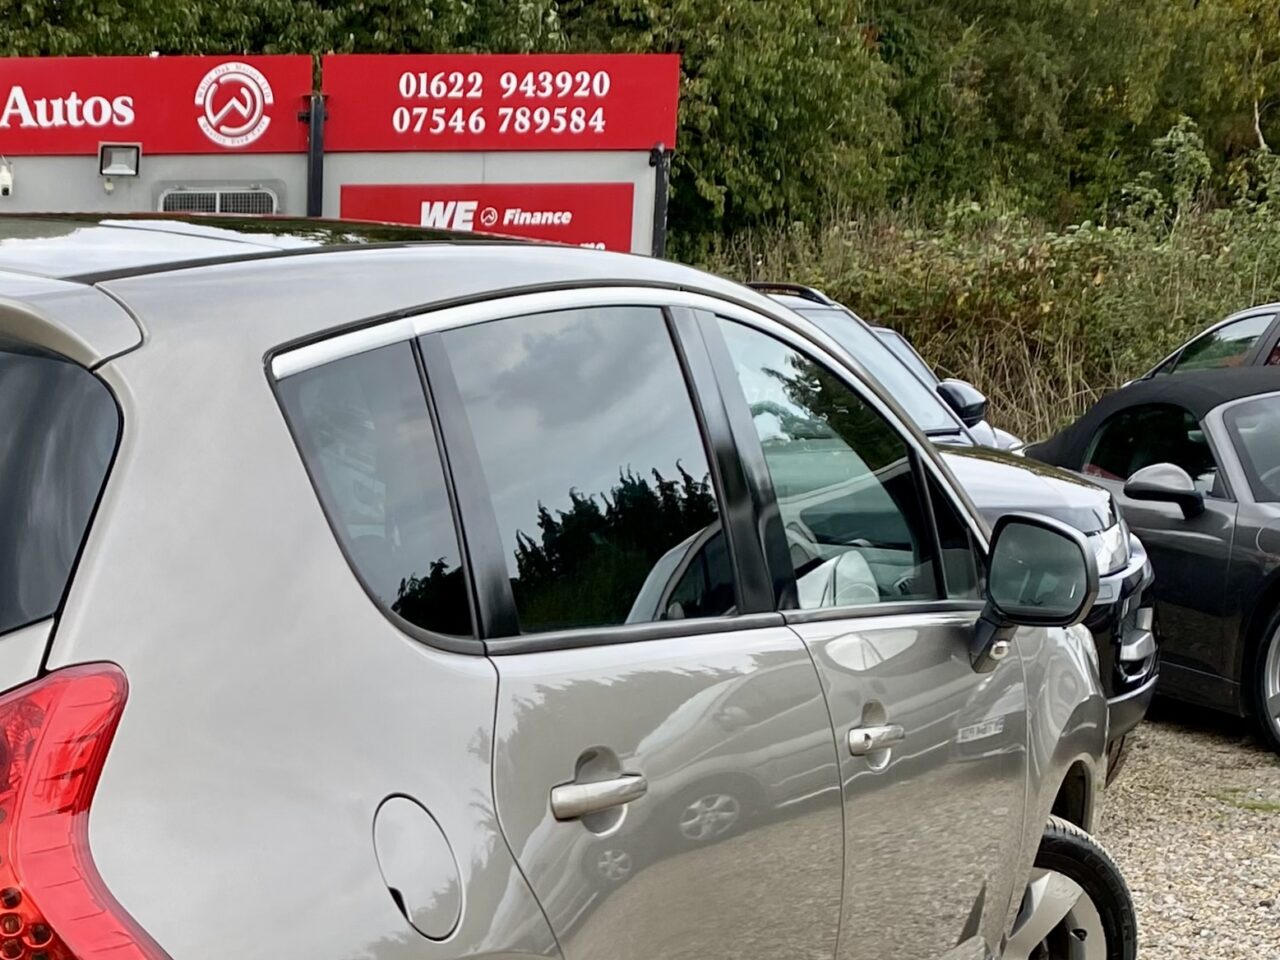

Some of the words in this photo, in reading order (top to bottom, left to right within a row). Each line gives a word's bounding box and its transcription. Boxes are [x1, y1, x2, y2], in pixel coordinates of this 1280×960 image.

[398, 71, 484, 99] 01622
[499, 70, 612, 99] 943920
[392, 106, 487, 134] 07546
[498, 106, 607, 134] 789584
[420, 201, 479, 232] WE
[503, 208, 573, 226] Finance
